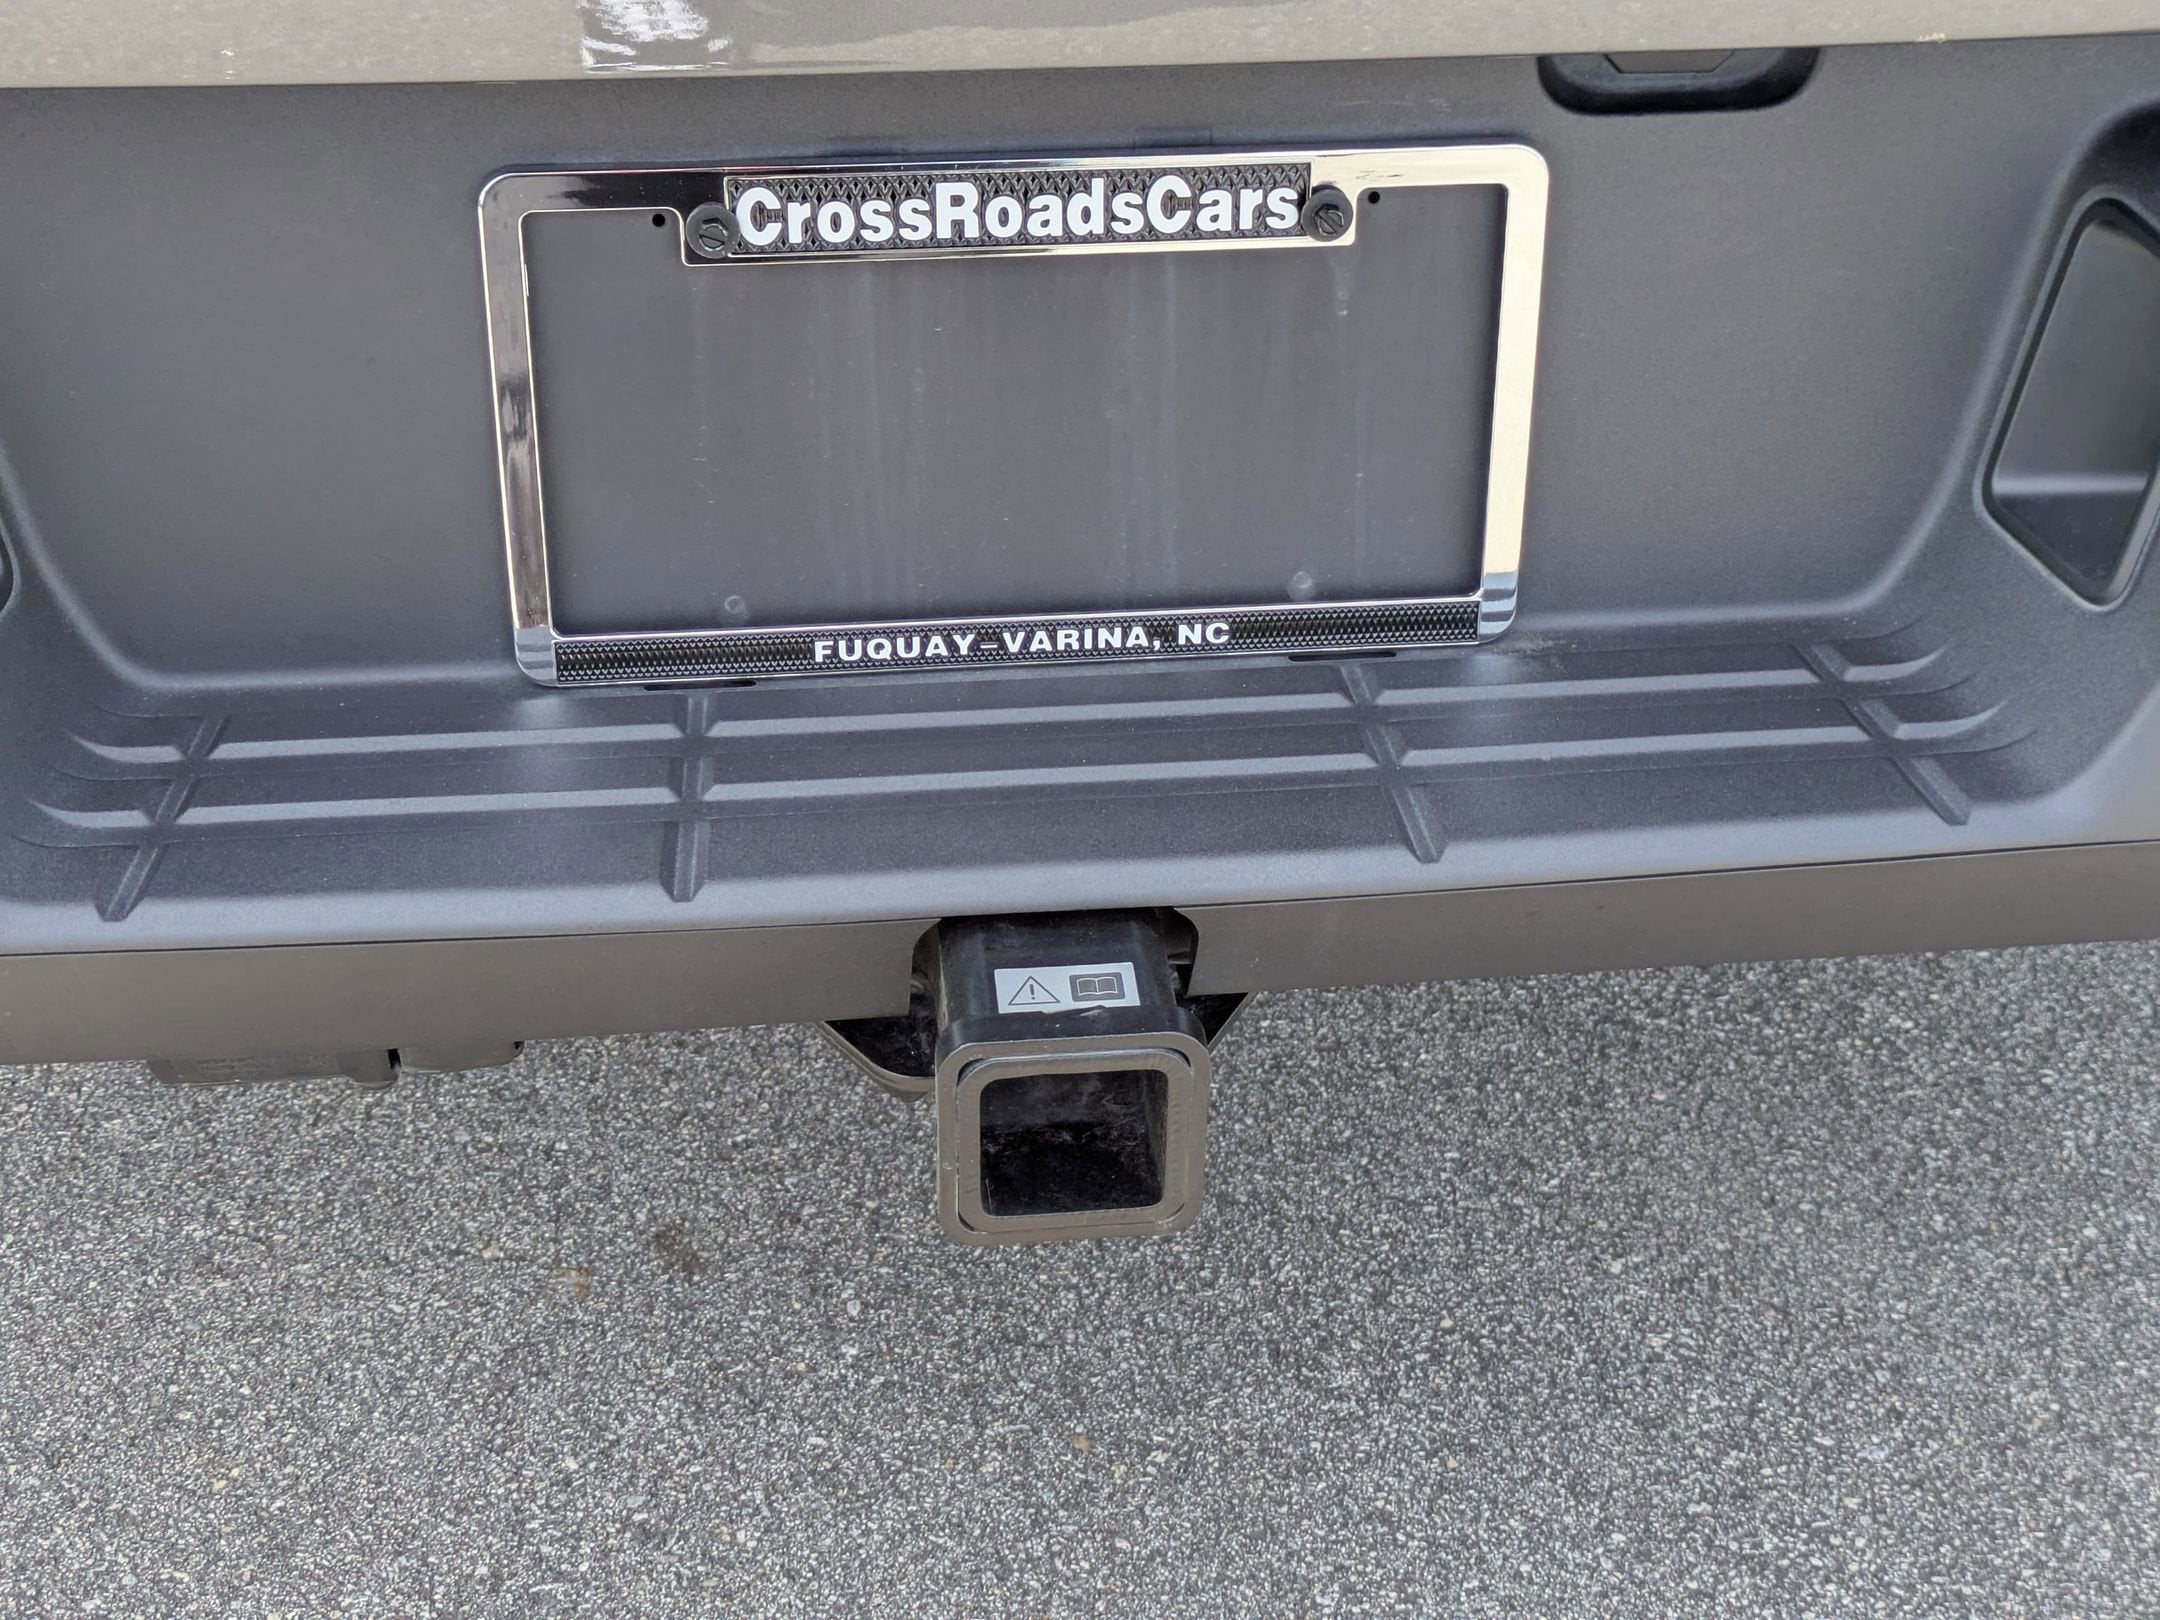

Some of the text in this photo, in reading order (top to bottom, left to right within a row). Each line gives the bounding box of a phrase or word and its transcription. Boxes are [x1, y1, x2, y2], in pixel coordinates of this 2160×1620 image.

[735, 174, 1300, 247] CrossRoadsCars
[813, 622, 1231, 663] FUQUAY-VARINA, NC
